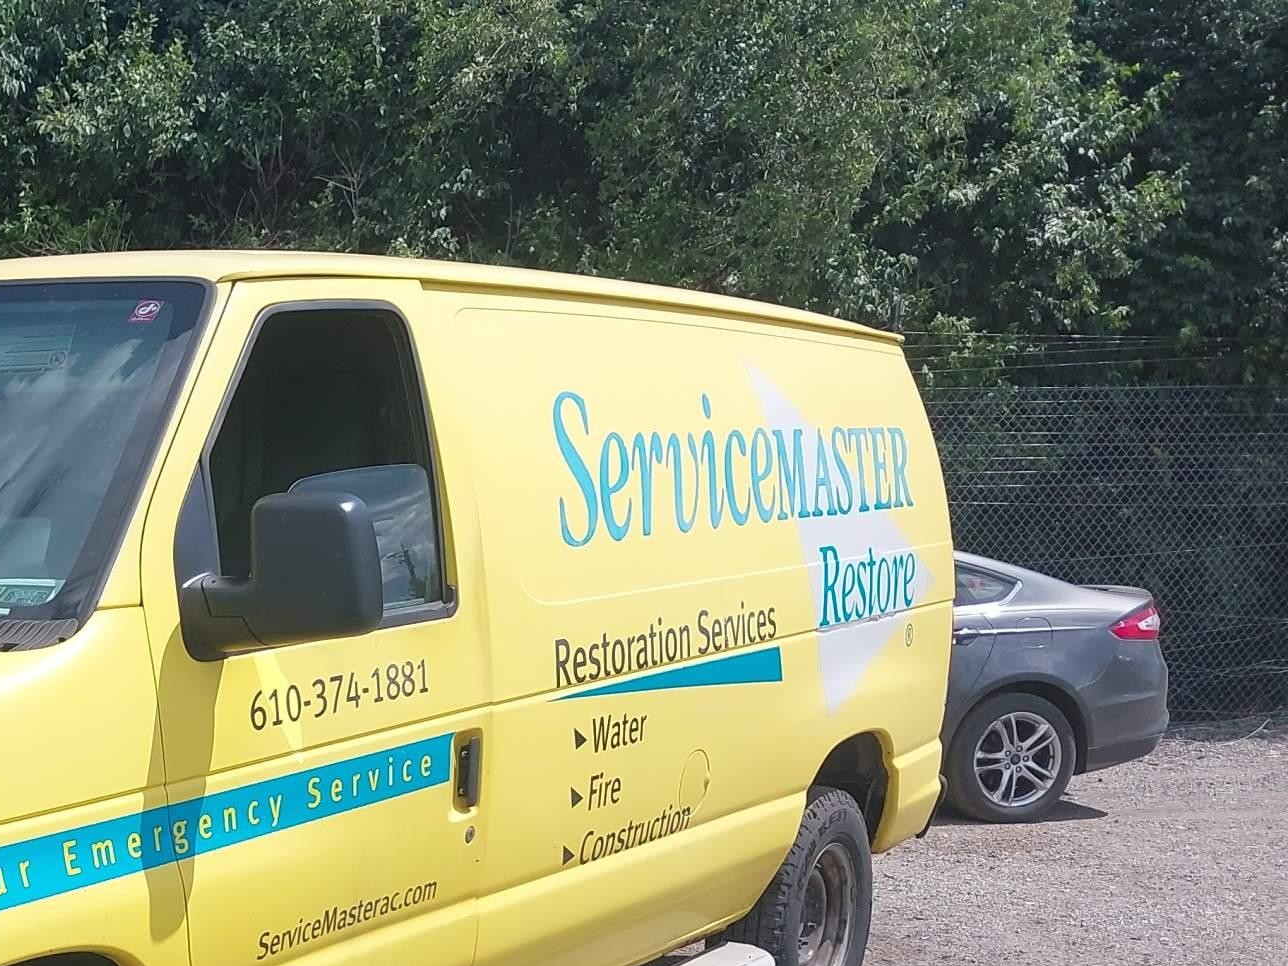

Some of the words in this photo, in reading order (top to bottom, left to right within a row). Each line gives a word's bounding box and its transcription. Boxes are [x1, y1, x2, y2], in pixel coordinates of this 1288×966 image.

[819, 546, 915, 626] Restore
[555, 618, 691, 688] Restoration
[698, 601, 777, 655] Services
[250, 659, 428, 731] 610-374-1881
[592, 712, 647, 753] Water
[64, 791, 282, 875] Emergency
[307, 751, 432, 809] Service
[588, 772, 621, 810] Fire
[579, 804, 691, 865] Construction
[257, 880, 437, 961] ServiceMasterac.com
